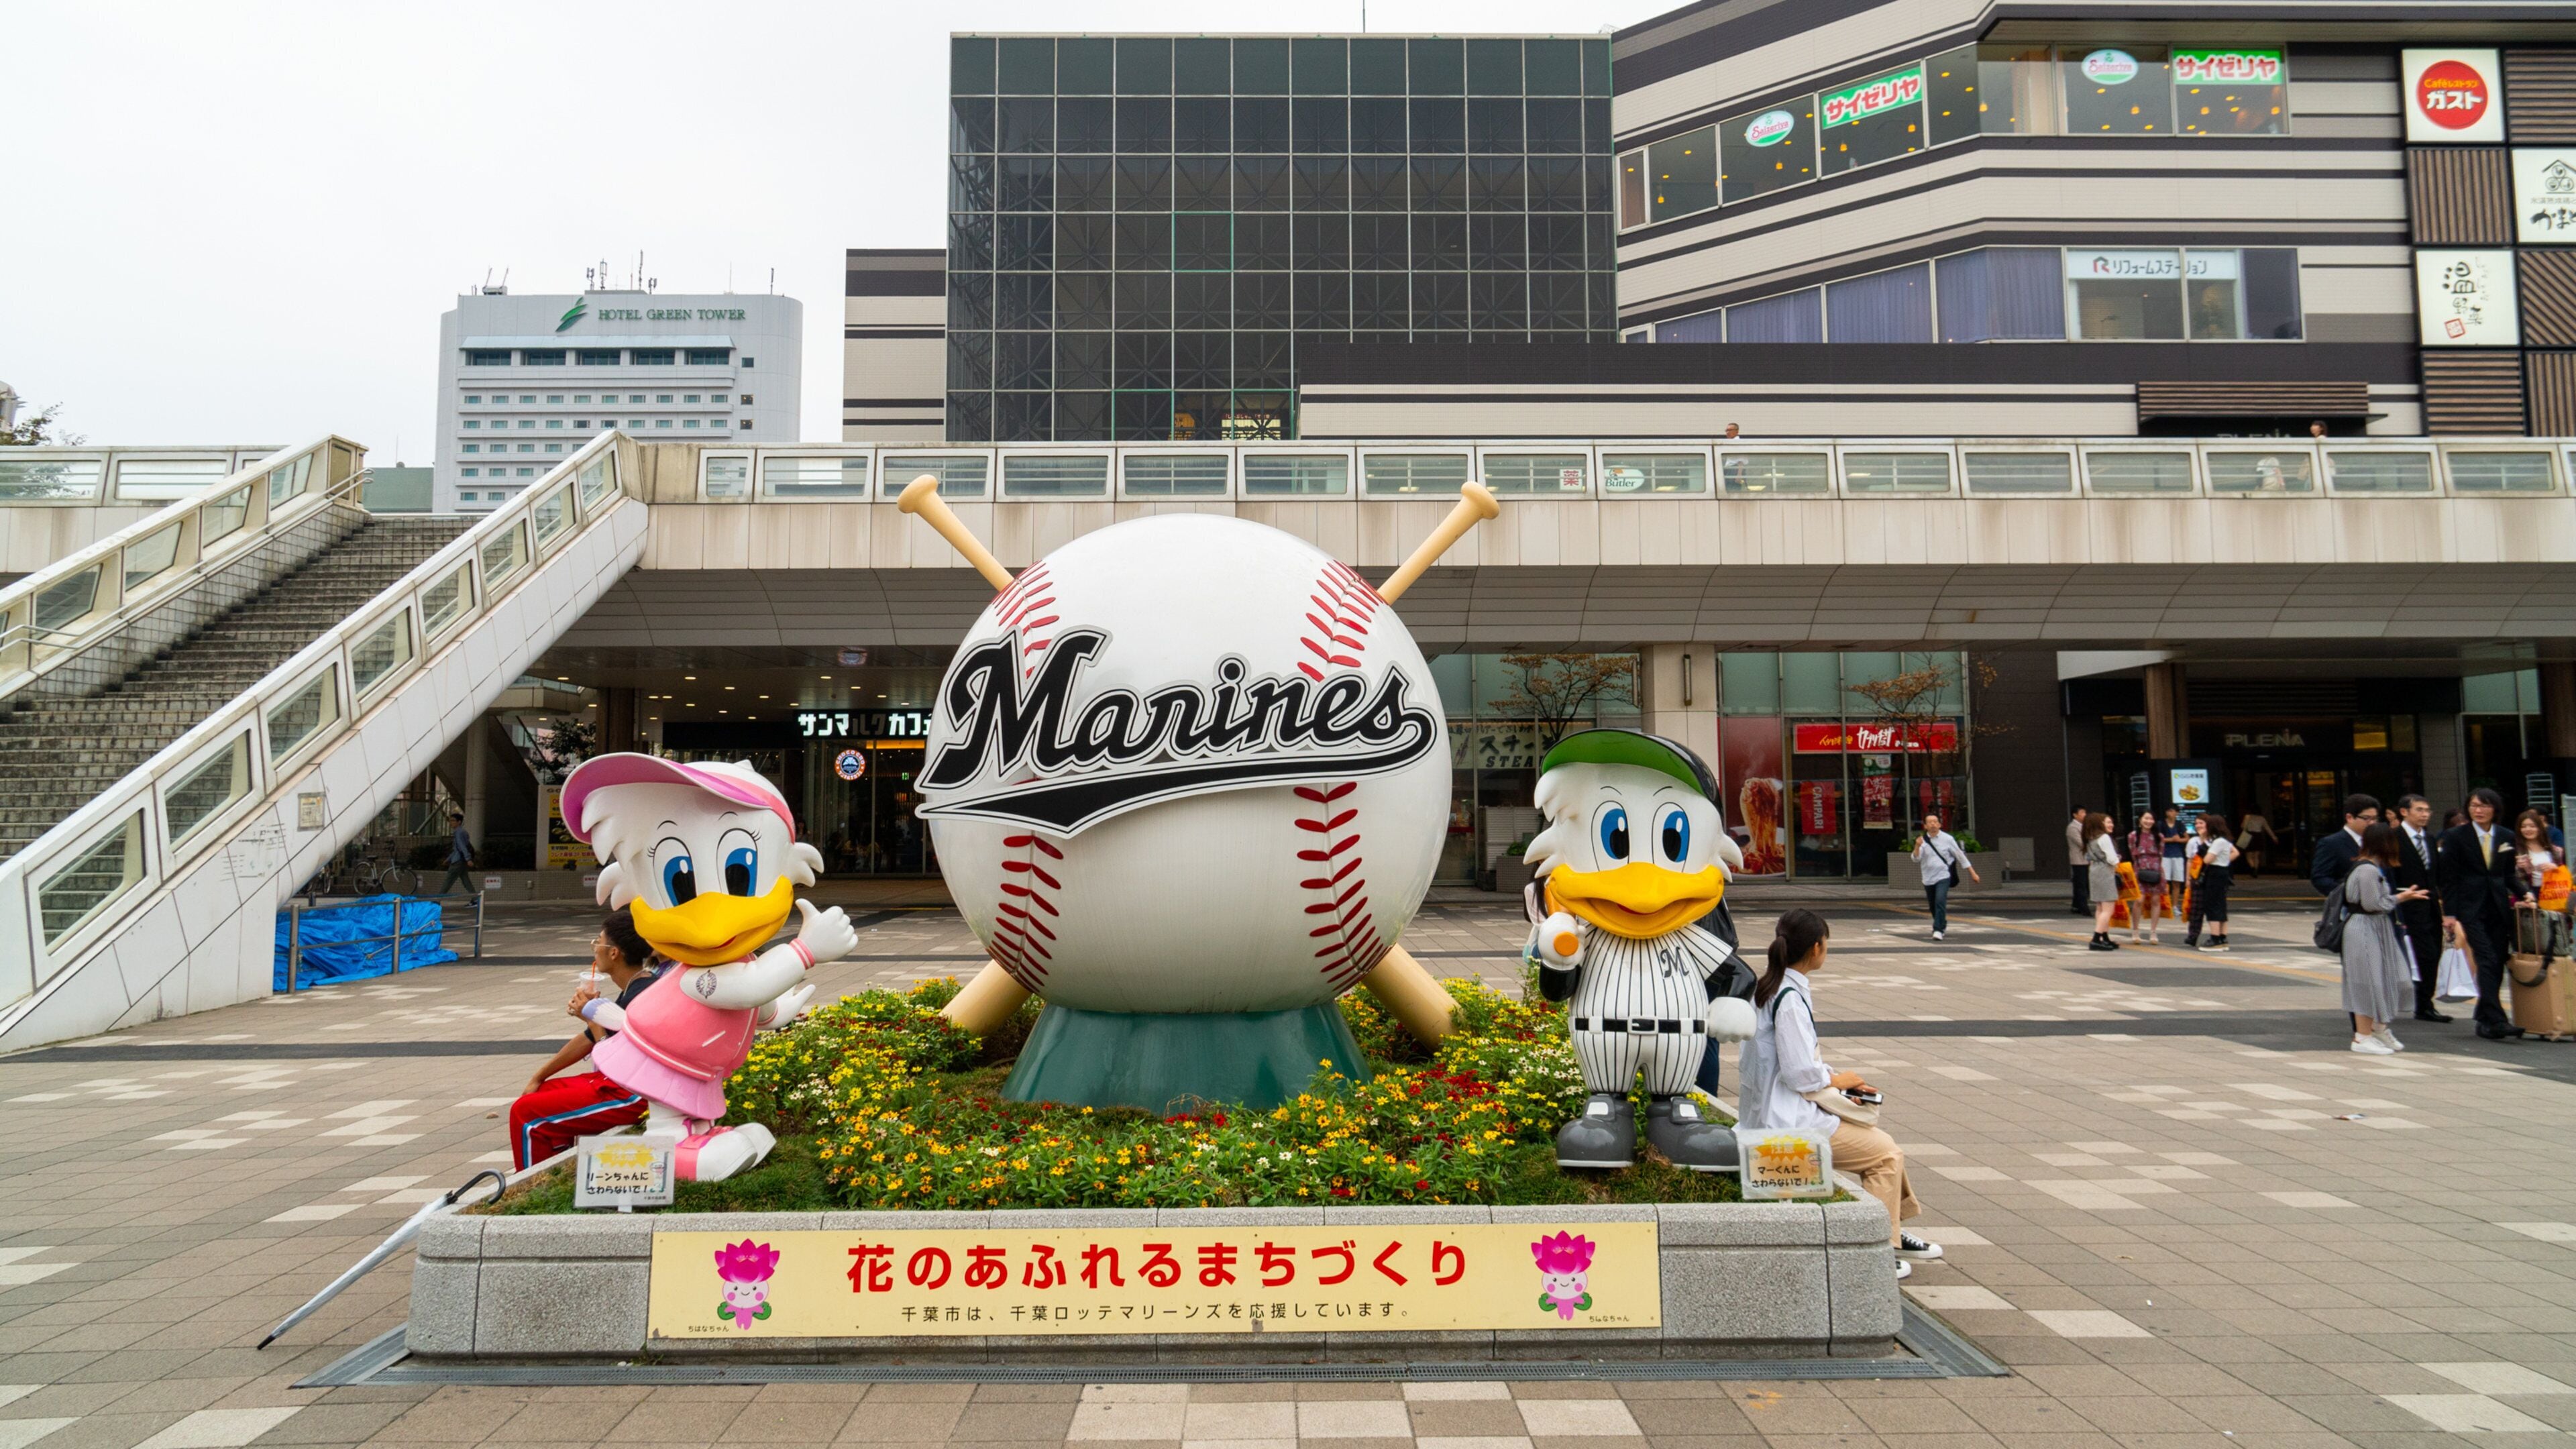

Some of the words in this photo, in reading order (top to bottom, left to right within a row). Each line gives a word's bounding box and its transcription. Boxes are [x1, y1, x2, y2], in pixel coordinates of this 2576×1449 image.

[2176, 56, 2277, 78] サイゼリヤ
[1825, 76, 1919, 121] サイゼリヤ
[2426, 90, 2483, 109] ガスト
[1751, 120, 1789, 140] Saizeriya
[598, 309, 642, 321] HOTEL
[646, 309, 692, 320] GREEN
[697, 309, 746, 321] TOWER
[1605, 478, 1635, 487] Butler
[917, 627, 1437, 795] Marines
[1486, 755, 1542, 767] STEA
[1813, 786, 1825, 830] CAMPARI
[1660, 945, 1690, 979] M
[588, 1172, 649, 1182] リーンちゃんに
[1758, 1165, 1800, 1175] マーくんに
[587, 1185, 647, 1195] さわらないで！
[1752, 1177, 1808, 1187] さわらないで！
[847, 1240, 1467, 1293] 花のあふれるまちづくり
[901, 1302, 1409, 1323] 千葉市は、千葉ロッテマリーンズを応援しています。
[688, 1325, 730, 1333] ちはなちゃん
